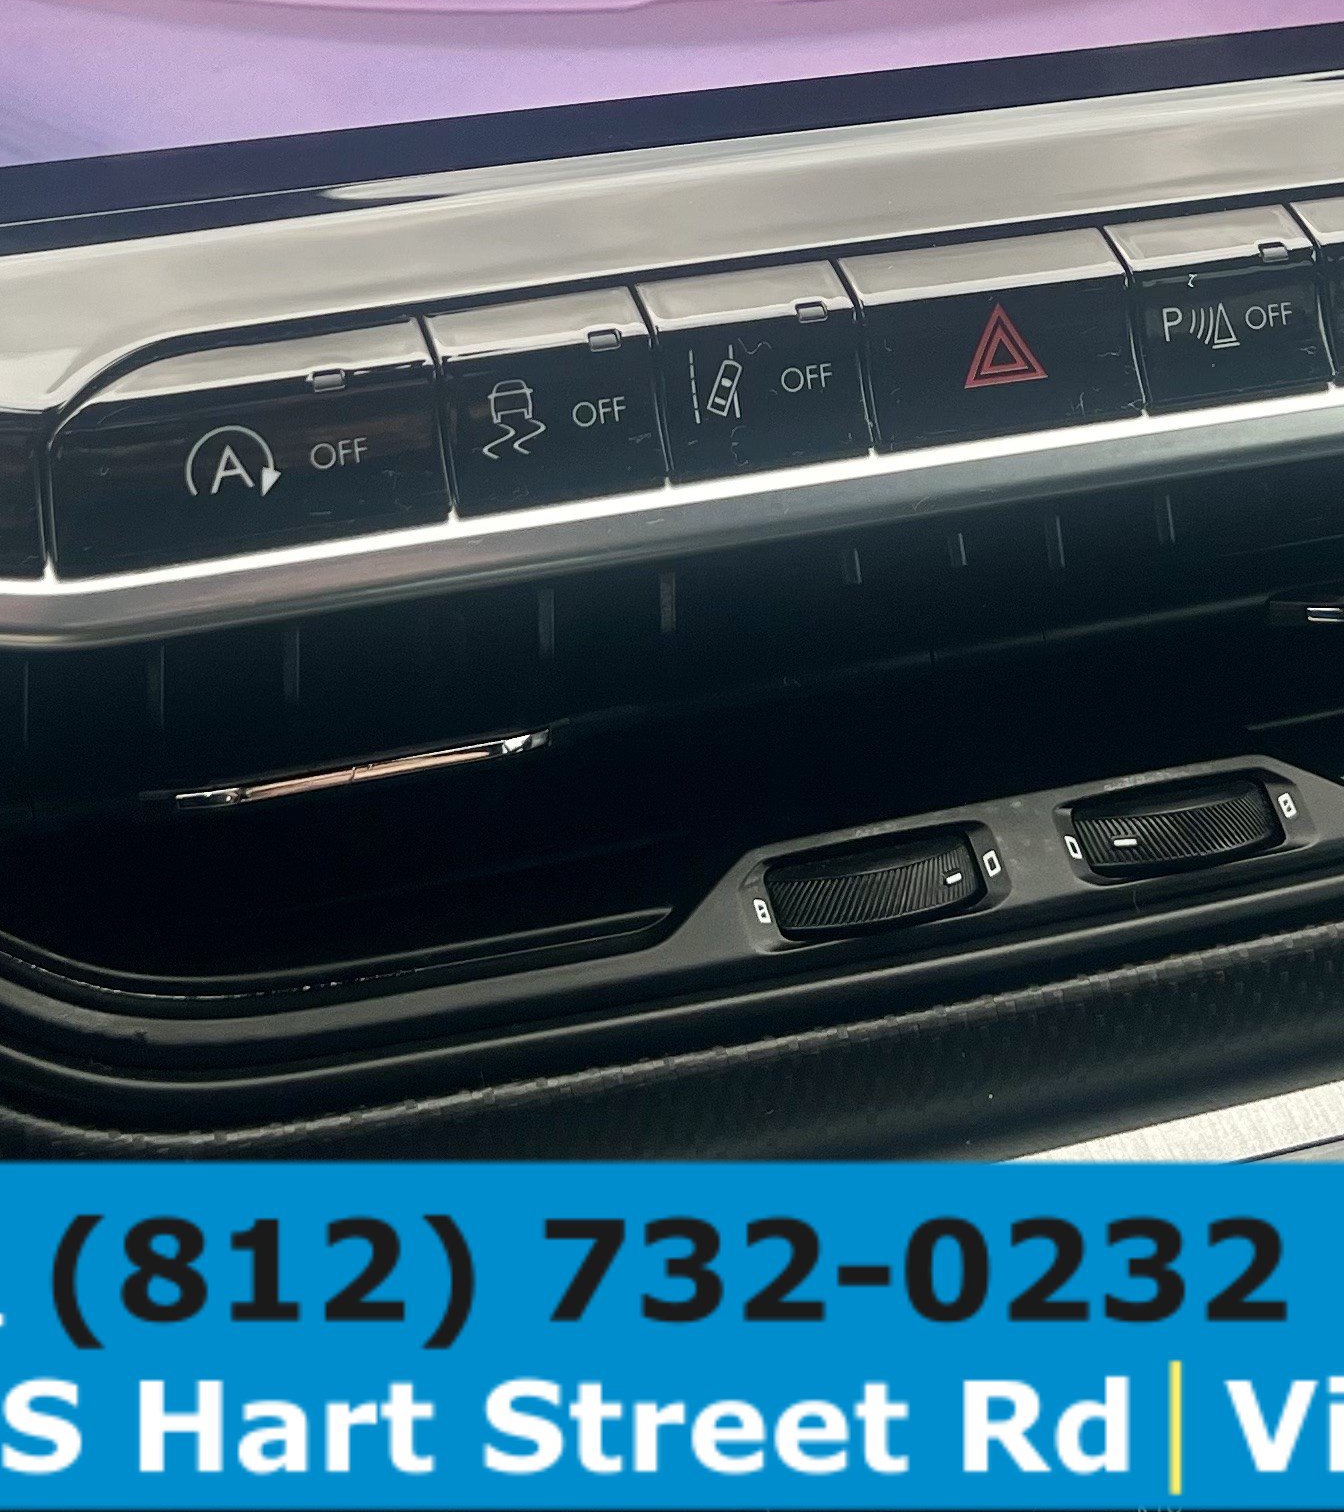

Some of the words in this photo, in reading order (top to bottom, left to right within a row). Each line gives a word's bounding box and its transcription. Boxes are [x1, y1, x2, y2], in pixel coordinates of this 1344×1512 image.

[1244, 301, 1294, 331] OFF
[780, 362, 834, 394] OFF
[571, 395, 628, 429] OFF
[309, 437, 369, 471] OFF
